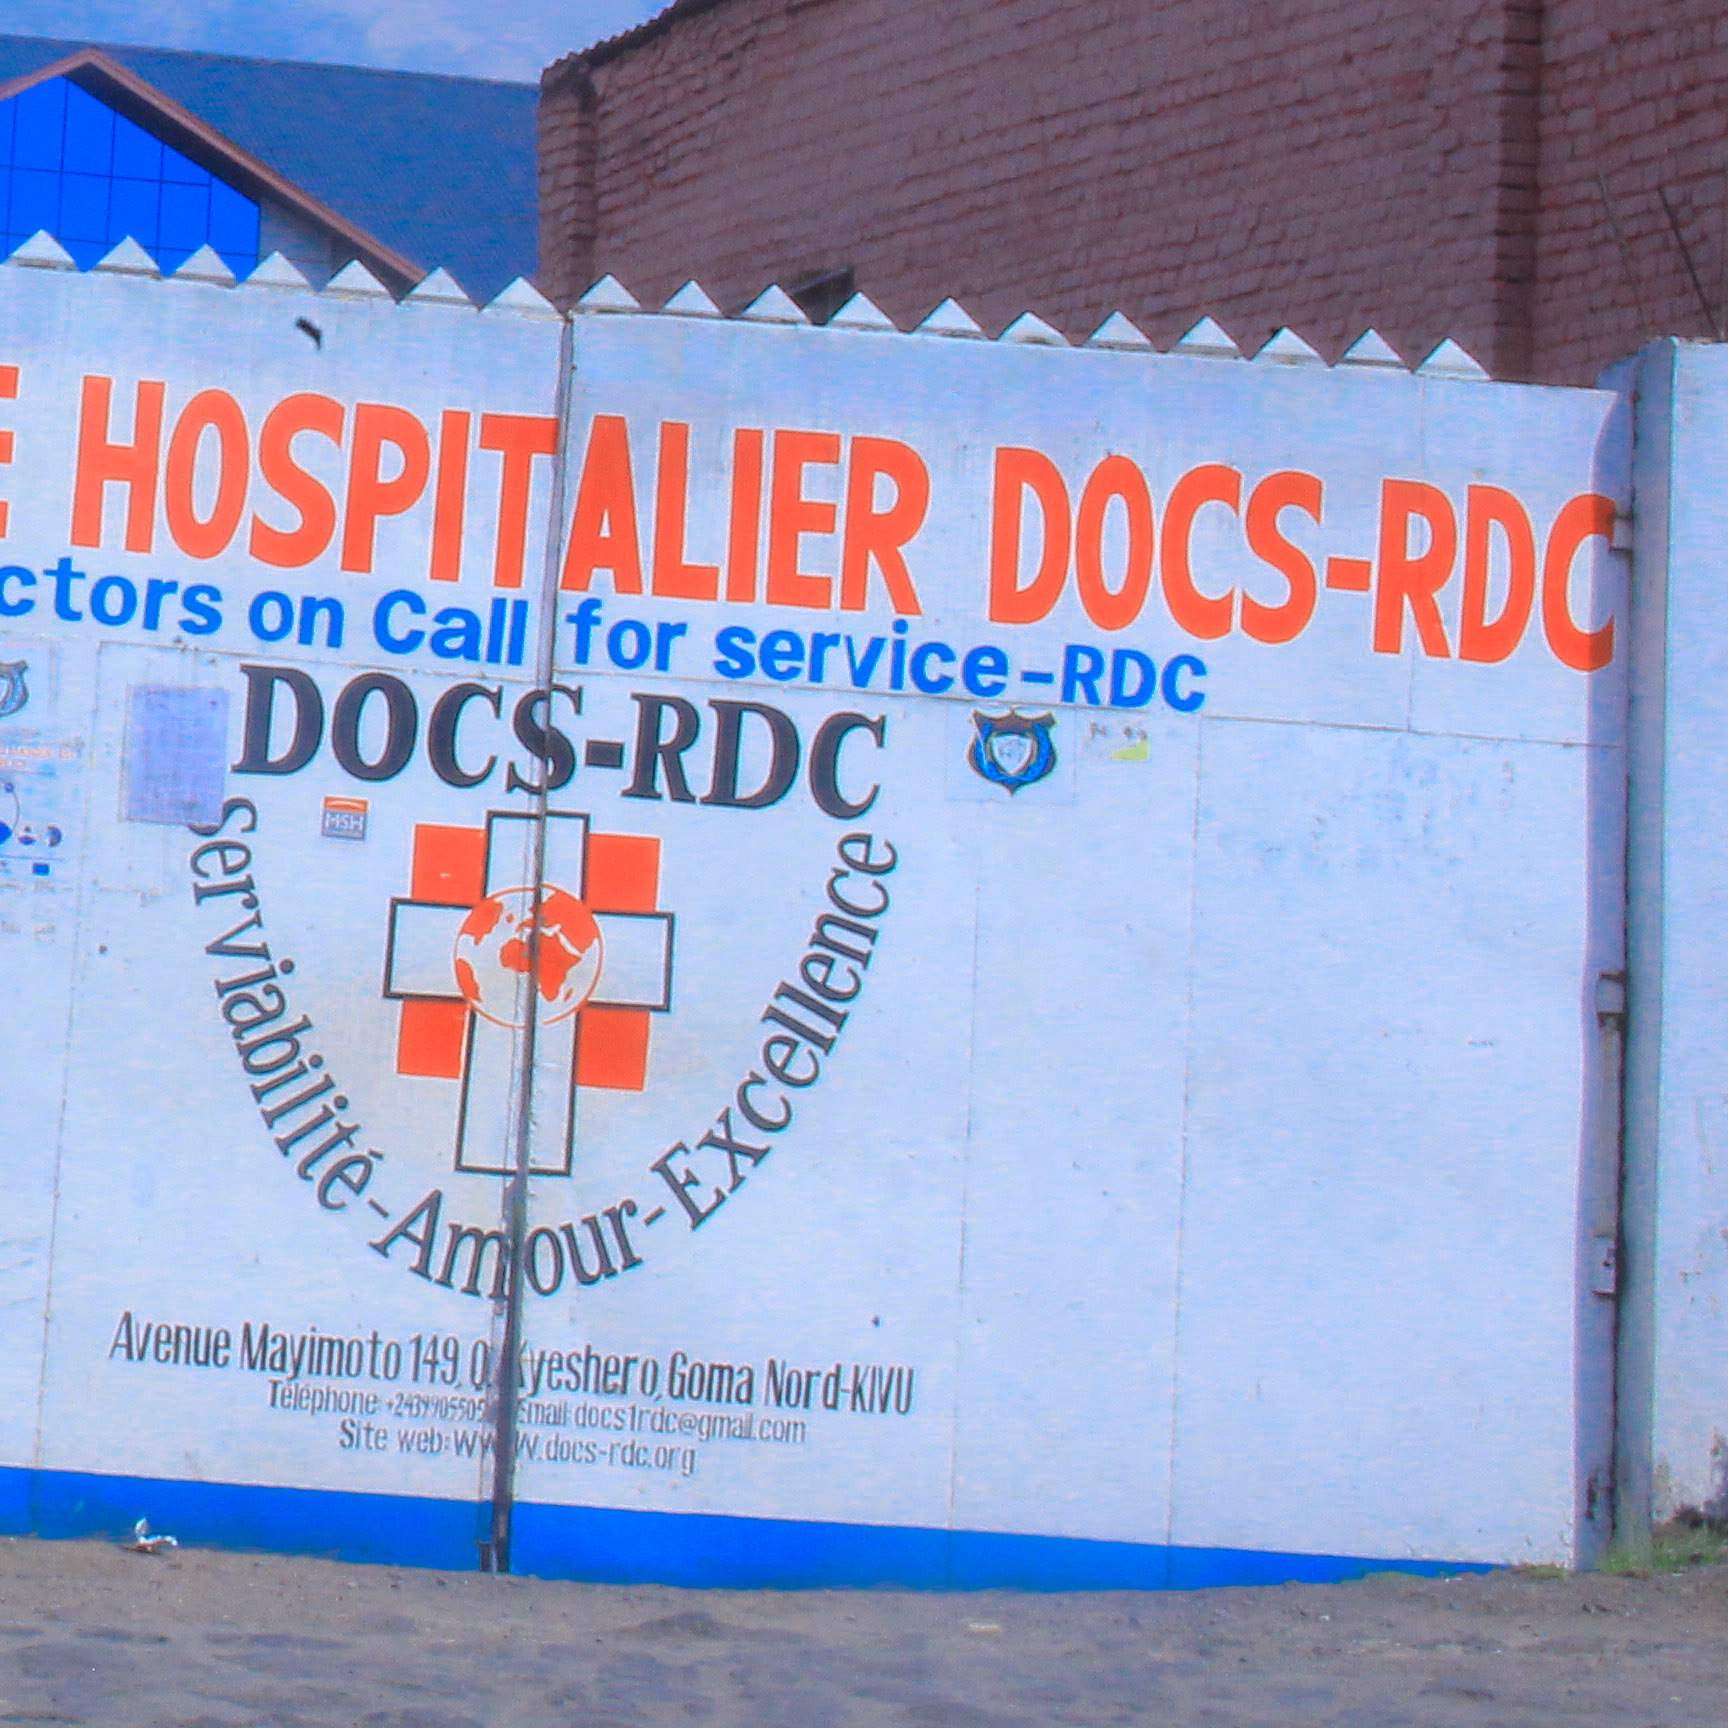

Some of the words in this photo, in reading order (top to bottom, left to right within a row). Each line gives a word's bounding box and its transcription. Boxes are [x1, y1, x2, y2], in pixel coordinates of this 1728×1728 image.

[69, 374, 933, 617] HOSPITALIER
[987, 445, 1617, 673] DOCS-RDC
[249, 590, 346, 650] on
[374, 589, 529, 667] Call
[566, 597, 690, 673] for
[714, 619, 1209, 714] service-RDC
[230, 663, 887, 820] DOCS-RDC
[108, 1310, 231, 1367] Avenue
[239, 1321, 402, 1381] Mayimoto
[668, 1350, 755, 1405] Goma
[763, 1357, 915, 1414] Nord-KIVU
[338, 1416, 388, 1450] Site
